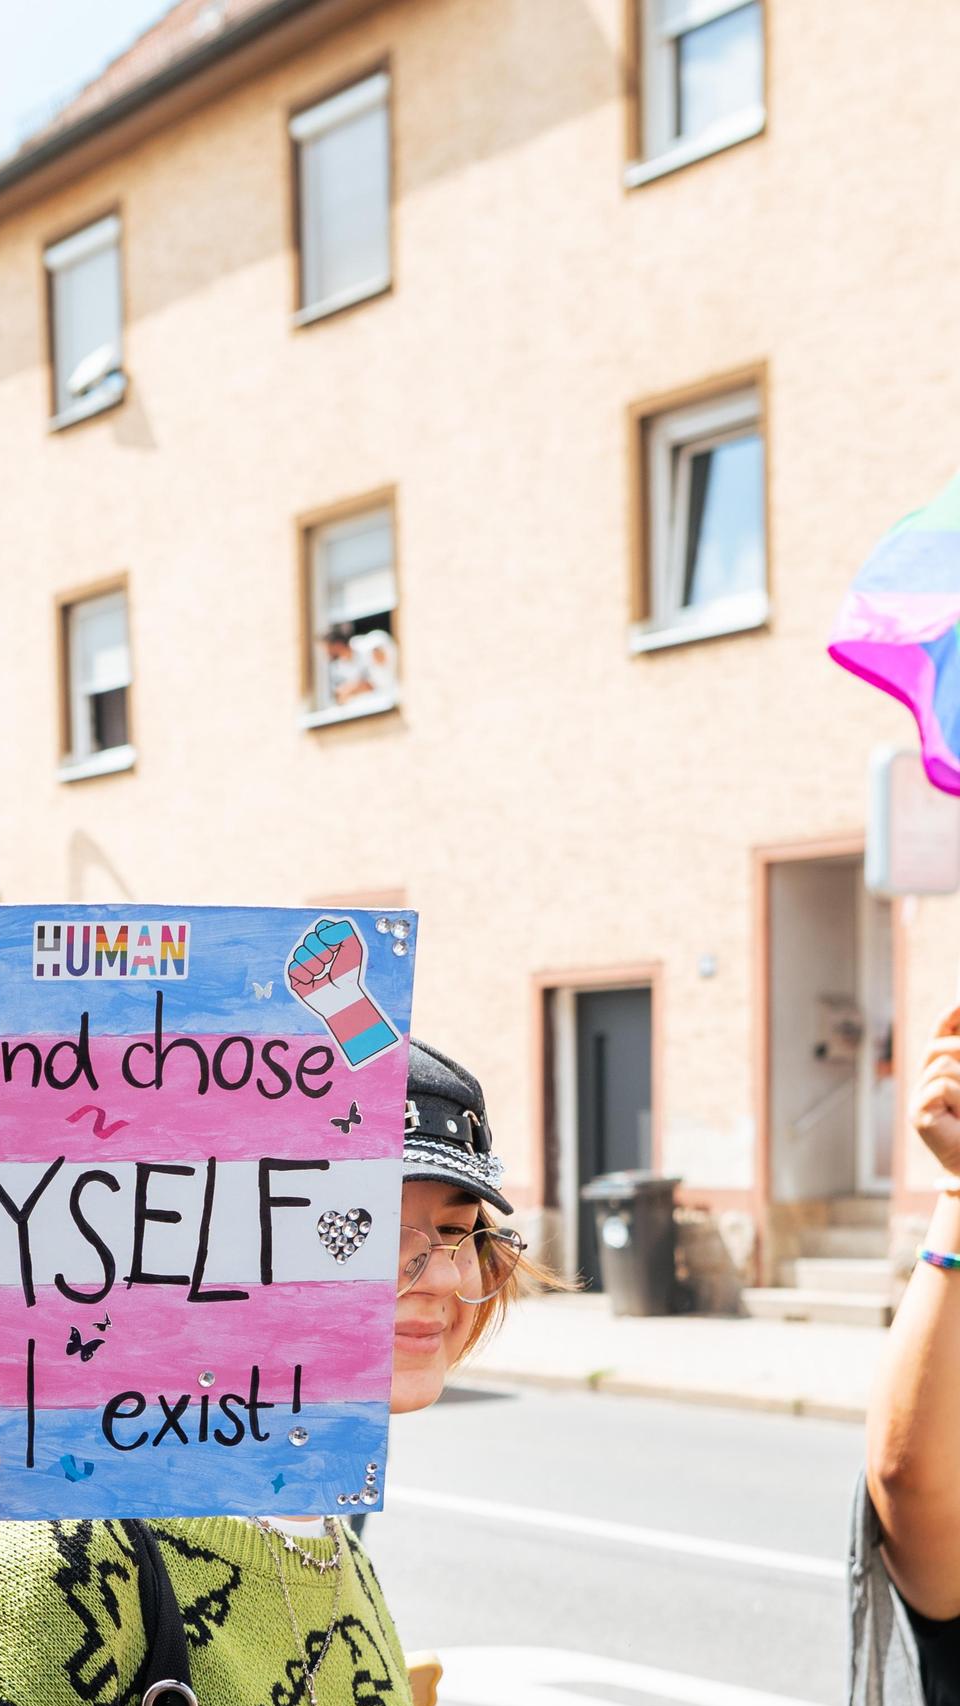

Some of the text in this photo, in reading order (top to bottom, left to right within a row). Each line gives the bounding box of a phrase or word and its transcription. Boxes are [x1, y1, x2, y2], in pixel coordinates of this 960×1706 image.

[36, 925, 186, 977] HUMAN
[121, 990, 335, 1100] chose
[26, 1338, 35, 1468] I
[101, 1364, 308, 1451] exist!
